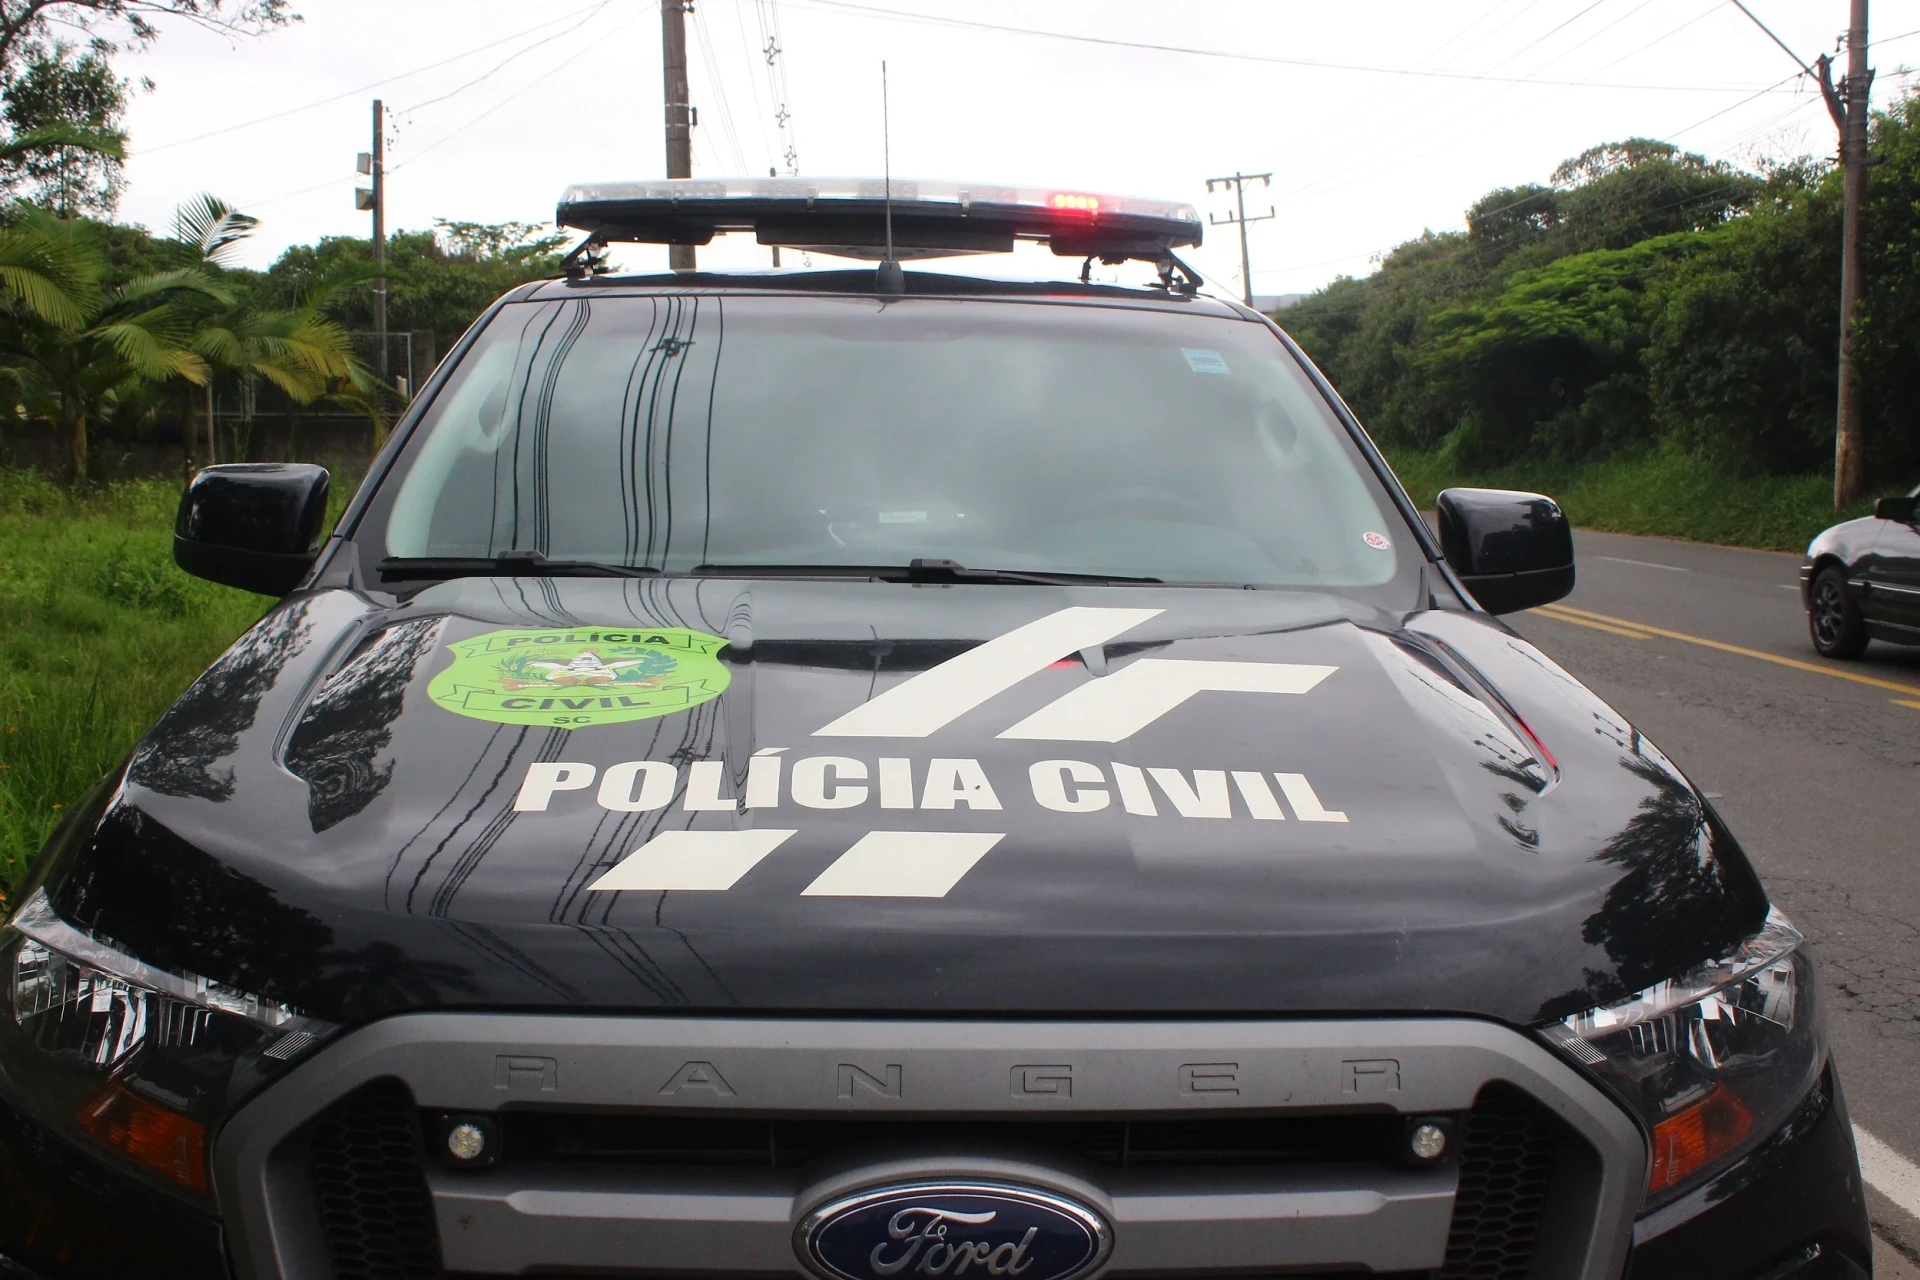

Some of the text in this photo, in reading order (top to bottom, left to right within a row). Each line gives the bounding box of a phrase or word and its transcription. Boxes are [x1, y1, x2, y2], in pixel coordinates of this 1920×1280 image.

[507, 633, 671, 647] POLÍCIA
[501, 696, 650, 710] CIVIL
[553, 716, 591, 725] SC
[513, 747, 1349, 823] POLÍCIA CIVIL
[494, 1054, 1400, 1099] RANGER
[870, 1206, 1038, 1275] Ford
